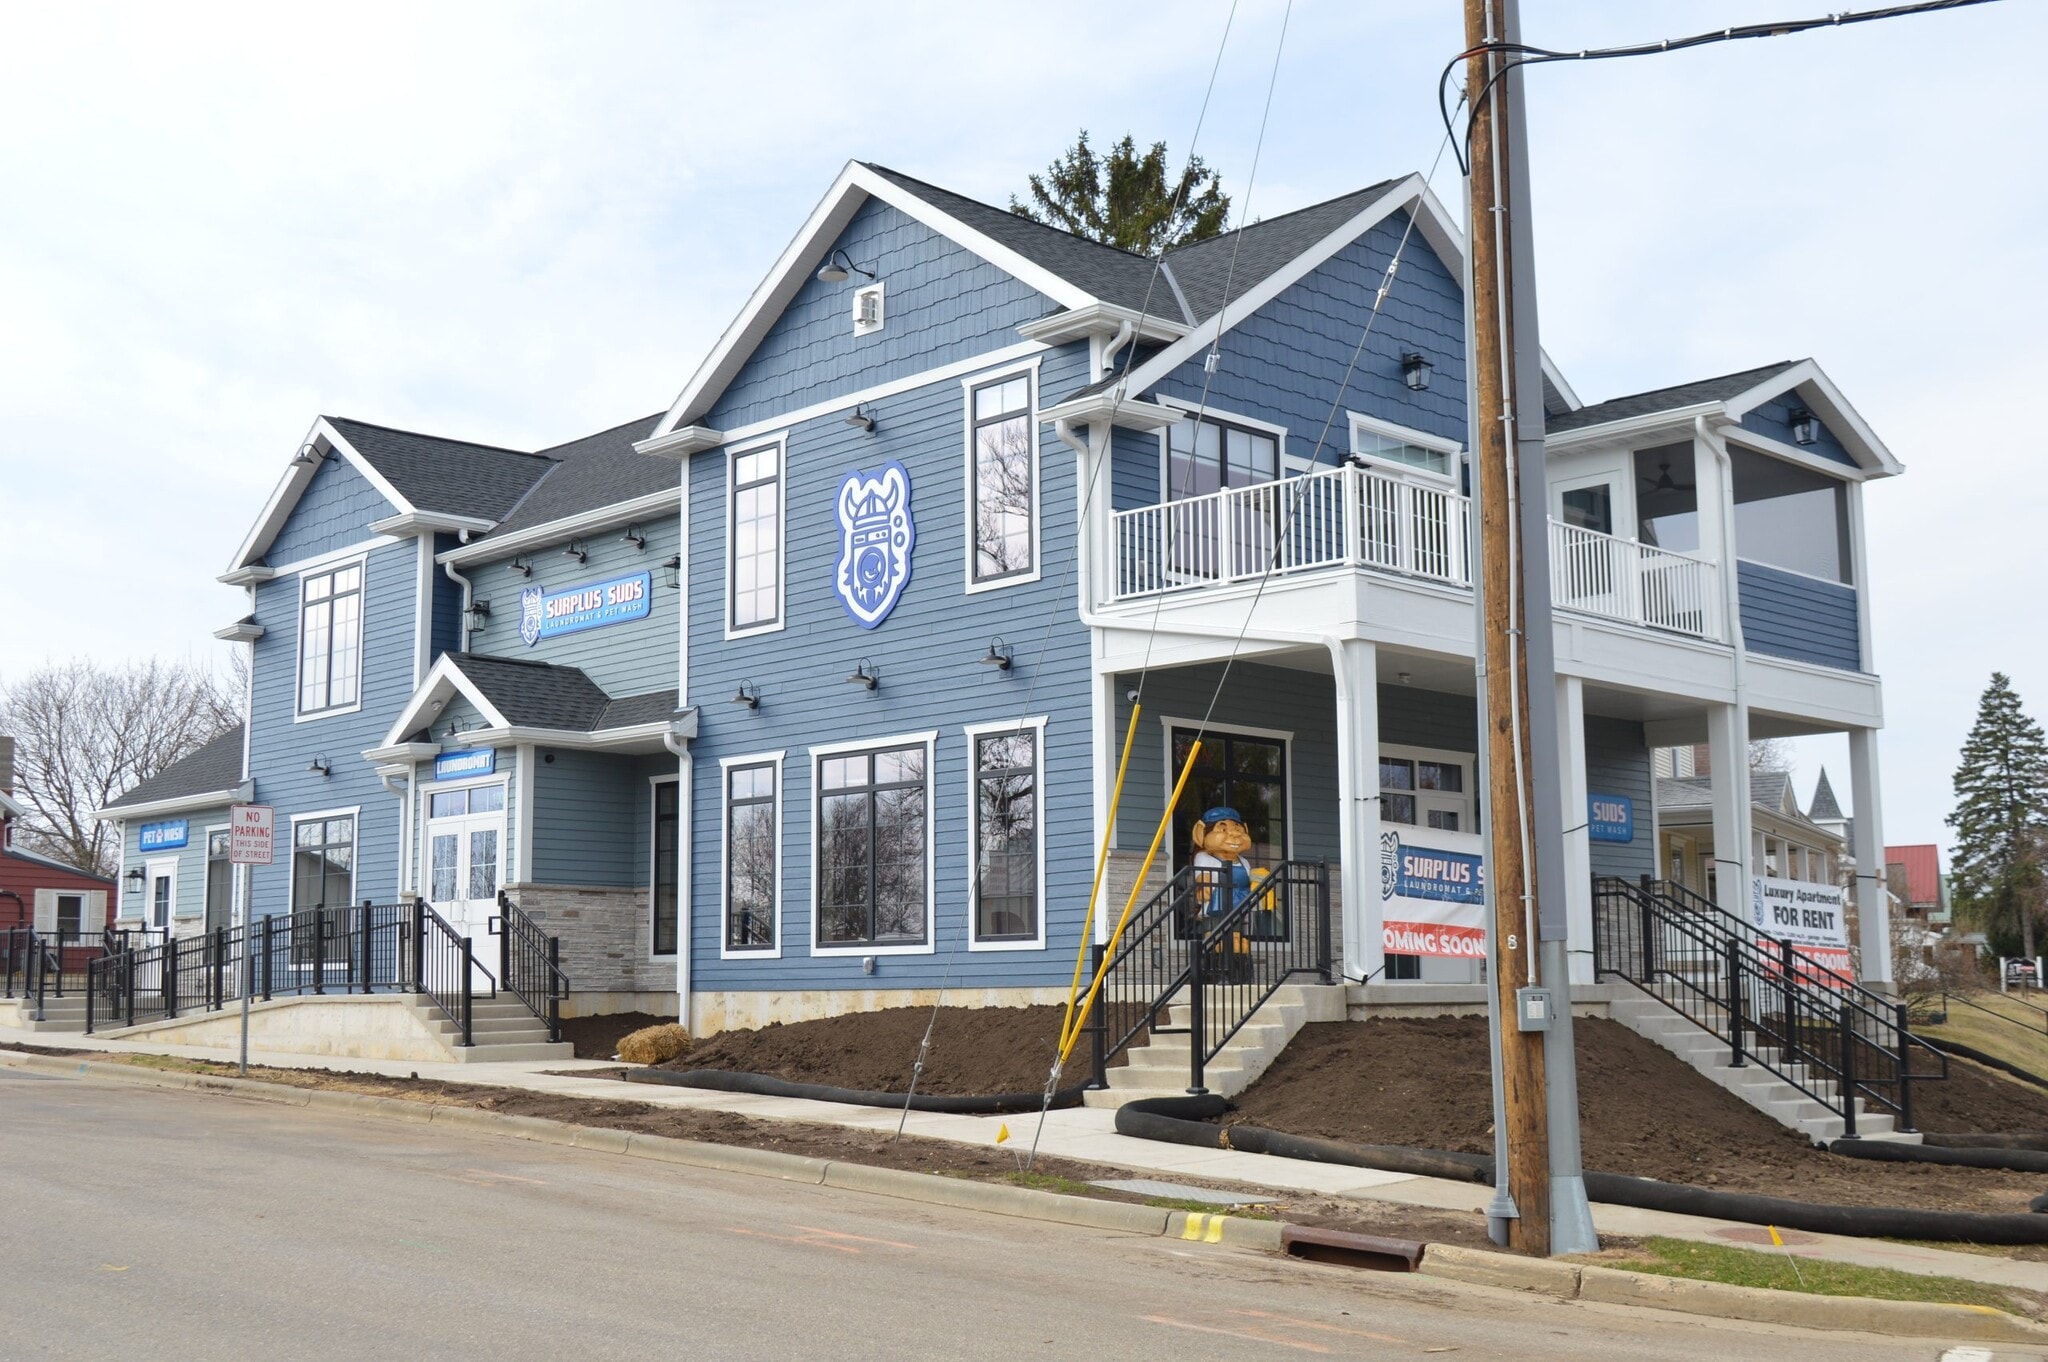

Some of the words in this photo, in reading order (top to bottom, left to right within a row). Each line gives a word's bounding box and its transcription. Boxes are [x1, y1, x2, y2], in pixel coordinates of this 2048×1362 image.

[546, 589, 603, 619] SURPLUS
[607, 580, 644, 606] SUDS
[546, 612, 594, 629] LAUNDROMAT
[605, 608, 619, 617] PET
[622, 602, 643, 613] WASH
[437, 754, 491, 774] LAUNDROMAT
[246, 811, 260, 823] NO
[1593, 801, 1627, 823] SUDS
[143, 830, 156, 844] PET
[164, 827, 184, 841] WASH
[235, 825, 271, 838] PARKING
[1591, 824, 1605, 833] PET
[1607, 826, 1627, 835] WASH
[234, 850, 243, 858] OF
[245, 850, 270, 859] STREET
[236, 840, 252, 848] THIS
[254, 840, 269, 849] SIDE
[1404, 856, 1470, 883] SURPLUS
[1404, 881, 1461, 894] LAUNDROMAT
[1764, 884, 1794, 903] Luxury
[1796, 889, 1841, 906] Apartment
[1773, 905, 1799, 927] FOR
[1802, 908, 1834, 930] RENT
[1383, 927, 1437, 952] OMING
